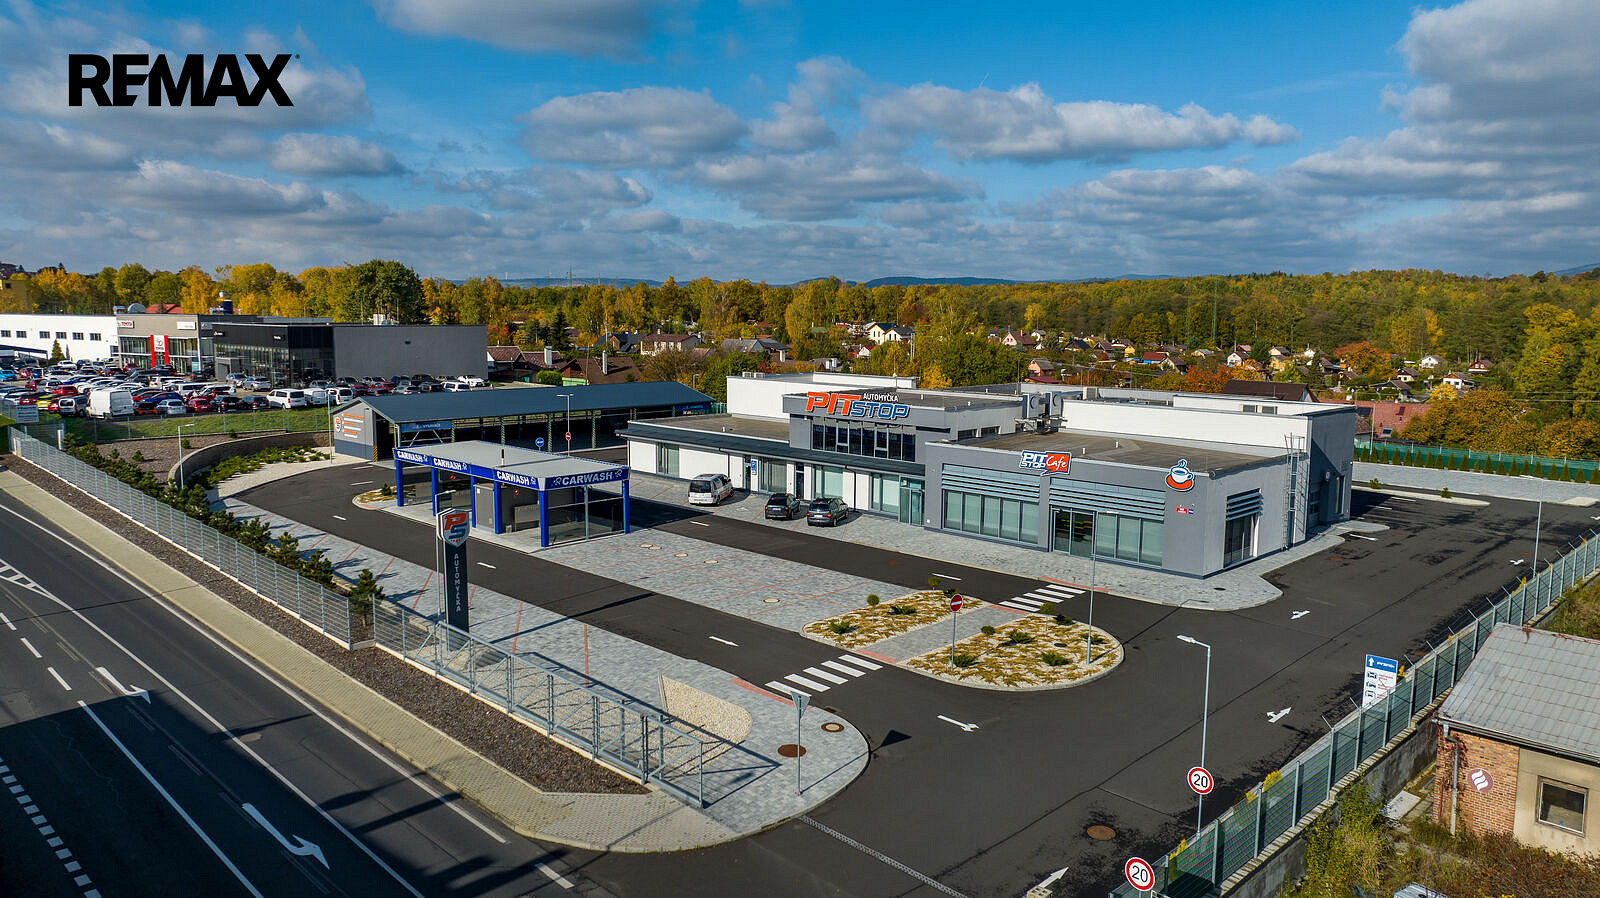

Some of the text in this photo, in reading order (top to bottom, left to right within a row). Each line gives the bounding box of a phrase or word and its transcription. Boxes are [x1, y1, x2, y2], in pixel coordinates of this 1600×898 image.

[805, 391, 860, 416] PIT
[863, 392, 899, 402] AUTOMYČKA
[850, 400, 910, 420] STOP
[397, 450, 424, 463] CARWASH
[433, 457, 462, 471] CARWASH
[1020, 460, 1046, 468] STOP
[1023, 452, 1048, 463] PIT
[1046, 455, 1067, 470] Cafe
[496, 470, 530, 486] CARWASH
[562, 471, 613, 486] CARWASH
[1193, 773, 1208, 788] 20
[1131, 865, 1148, 882] 20
